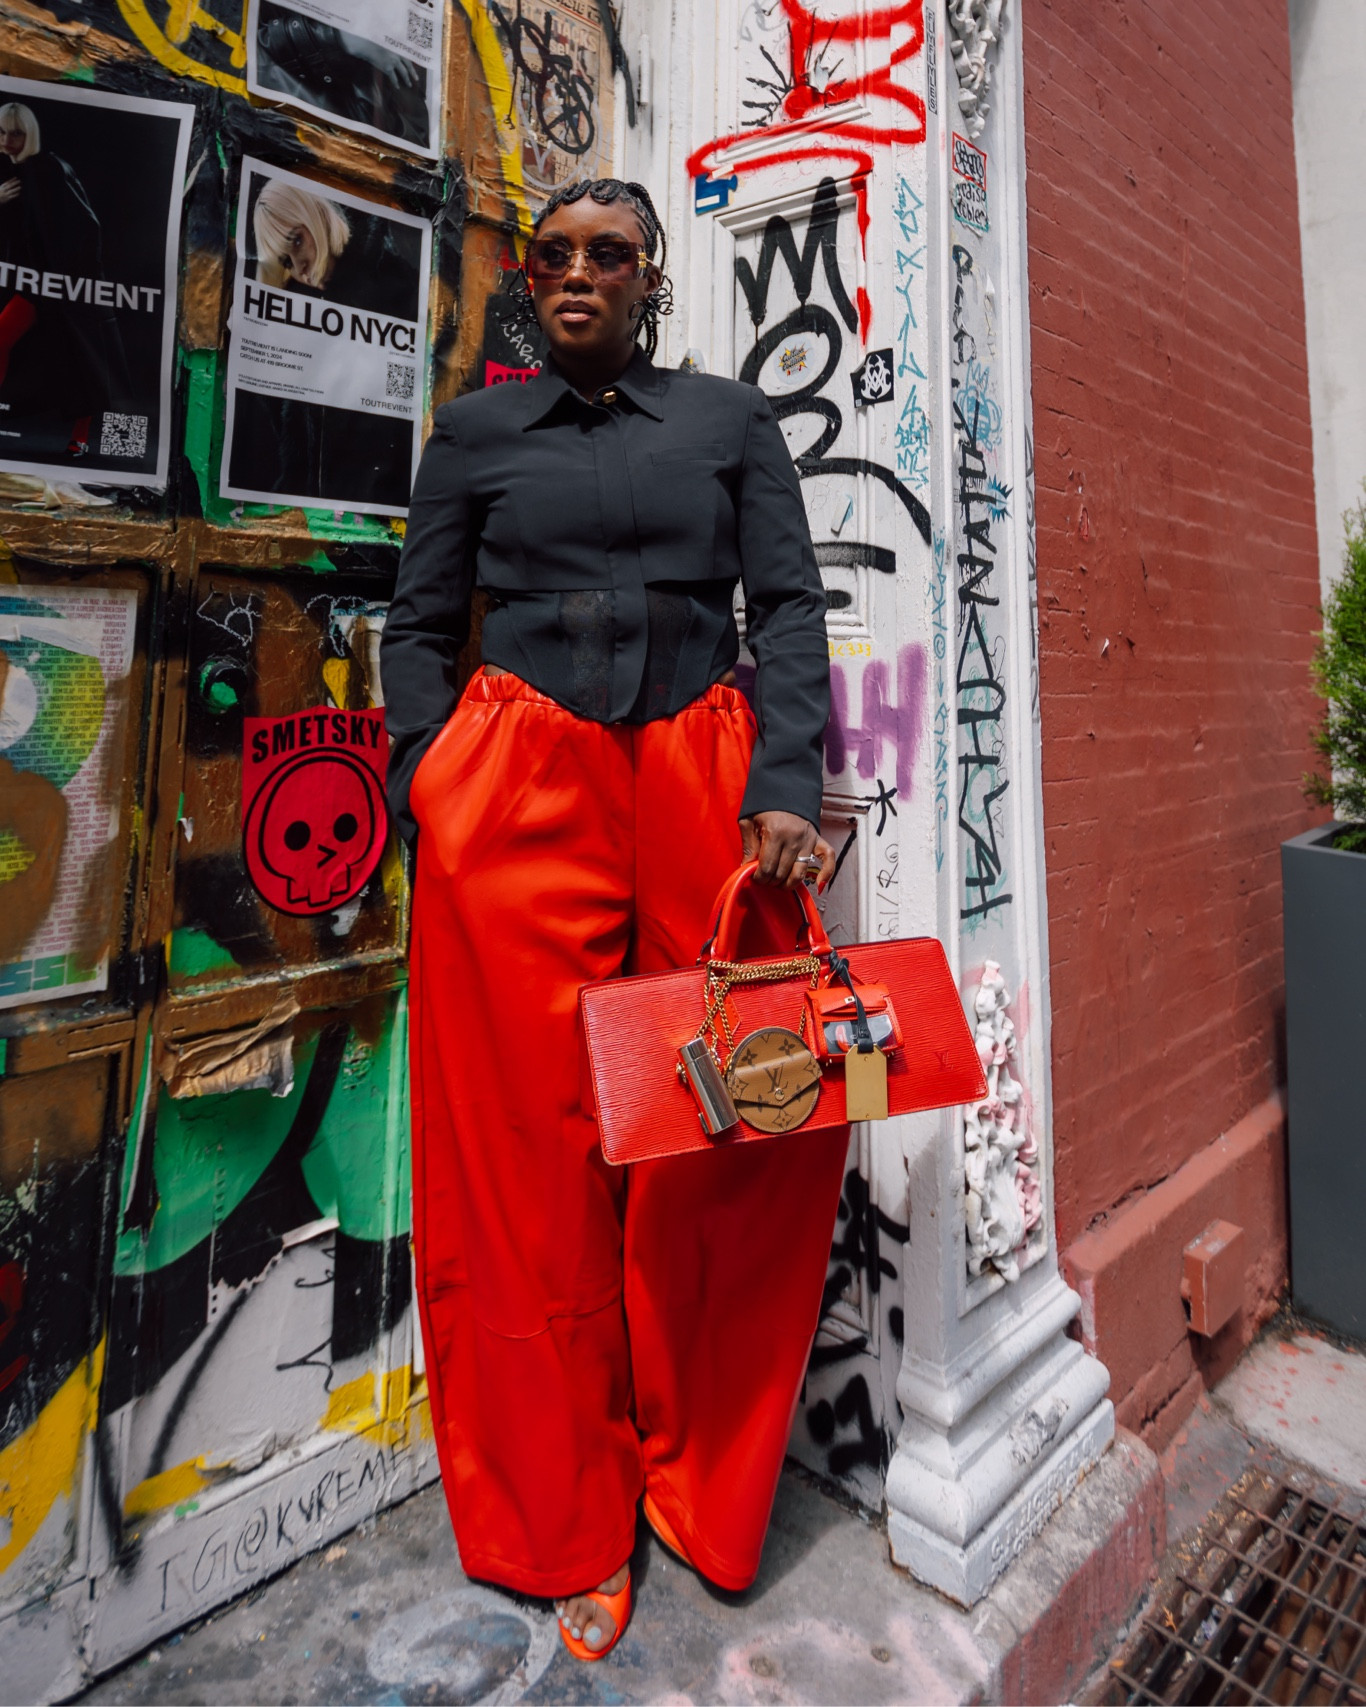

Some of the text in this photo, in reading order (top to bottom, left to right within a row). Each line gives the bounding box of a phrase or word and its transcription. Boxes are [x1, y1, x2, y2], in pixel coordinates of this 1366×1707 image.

[0, 261, 161, 313] TREVIENT
[244, 284, 416, 354] HELLO NYC!
[360, 397, 413, 414] TOUTREVIENT
[252, 713, 381, 764] SMETSKY
